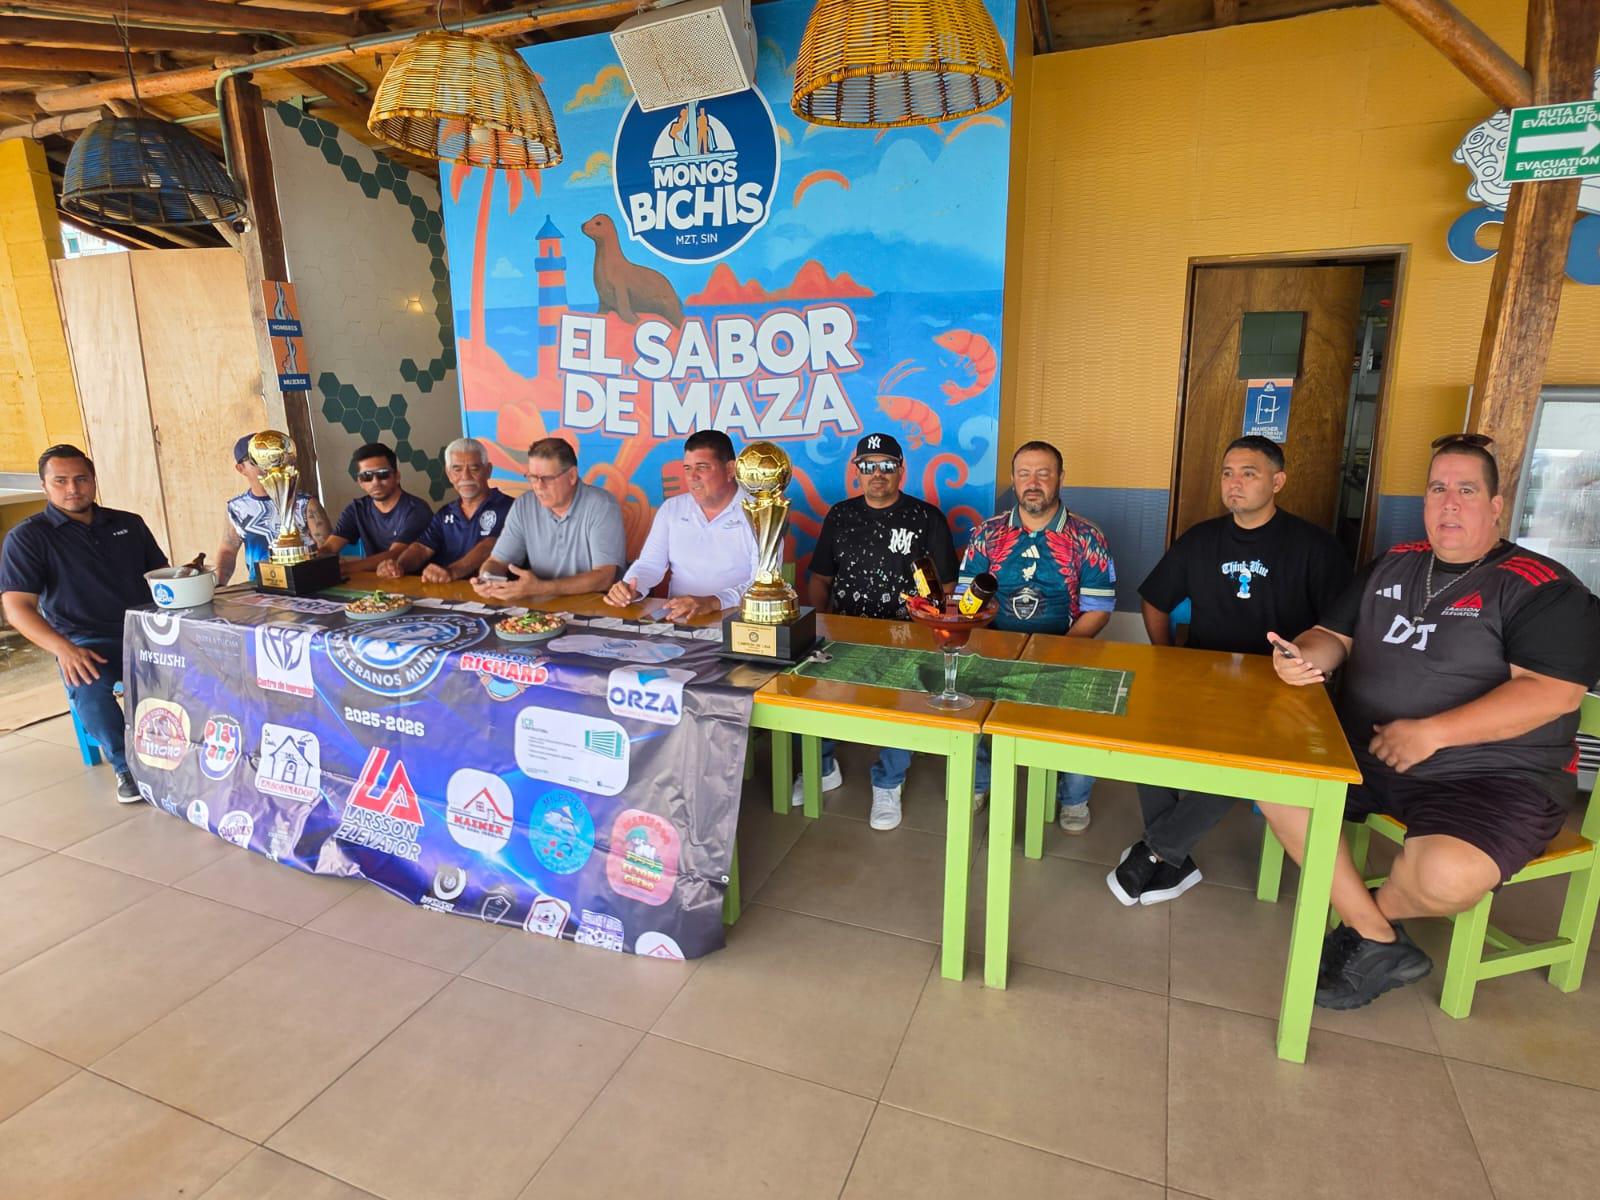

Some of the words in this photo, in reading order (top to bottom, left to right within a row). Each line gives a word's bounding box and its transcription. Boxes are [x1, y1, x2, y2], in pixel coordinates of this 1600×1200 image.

[1538, 107, 1573, 119] RUTA
[1576, 104, 1596, 115] DE
[653, 160, 739, 189] MONOS
[1516, 156, 1600, 171] EVACUATION
[1533, 166, 1578, 178] ROUTE
[628, 181, 764, 234] BICHIS
[675, 234, 699, 246] MZT,
[700, 233, 718, 244] SIN
[559, 314, 623, 376] EL
[632, 306, 860, 380] SABOR
[563, 373, 639, 435] DE
[653, 373, 859, 438] MAZA
[460, 654, 549, 685] RICHARD
[609, 687, 679, 715] ORZA
[344, 706, 425, 737] 2025-2026
[342, 804, 419, 842] LARSSON
[333, 822, 423, 862] ELEVATOR
